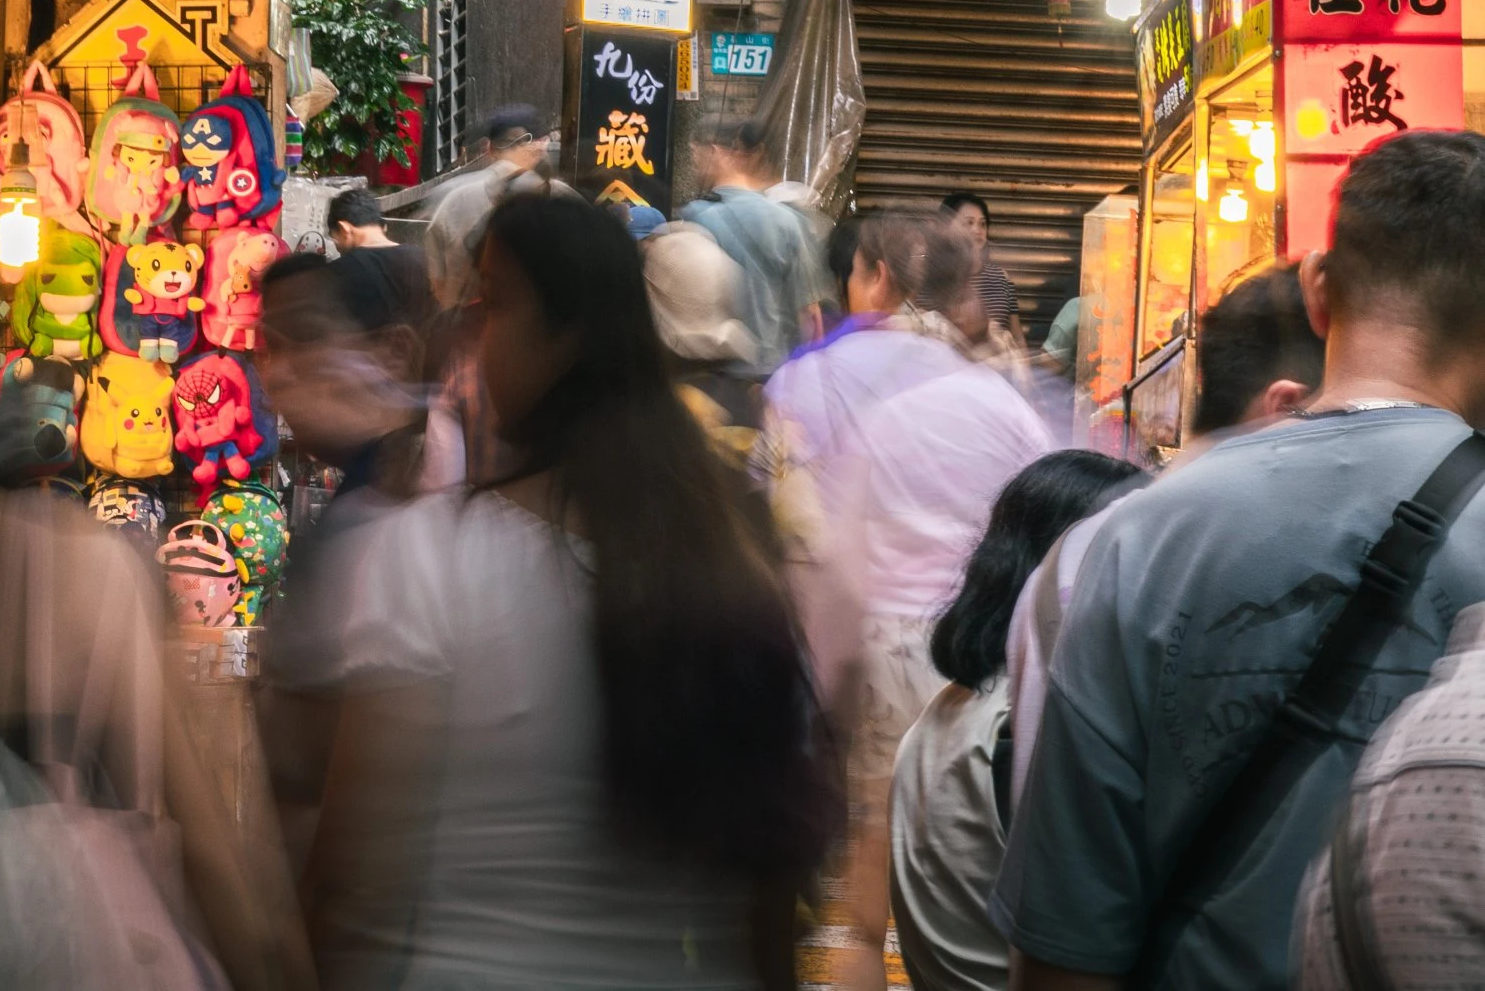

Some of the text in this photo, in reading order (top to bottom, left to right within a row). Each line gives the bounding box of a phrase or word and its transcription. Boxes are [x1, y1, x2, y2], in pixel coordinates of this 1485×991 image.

[594, 41, 665, 106] 九份
[732, 48, 768, 71] 151
[1339, 54, 1408, 131] 酸
[192, 117, 212, 135] A
